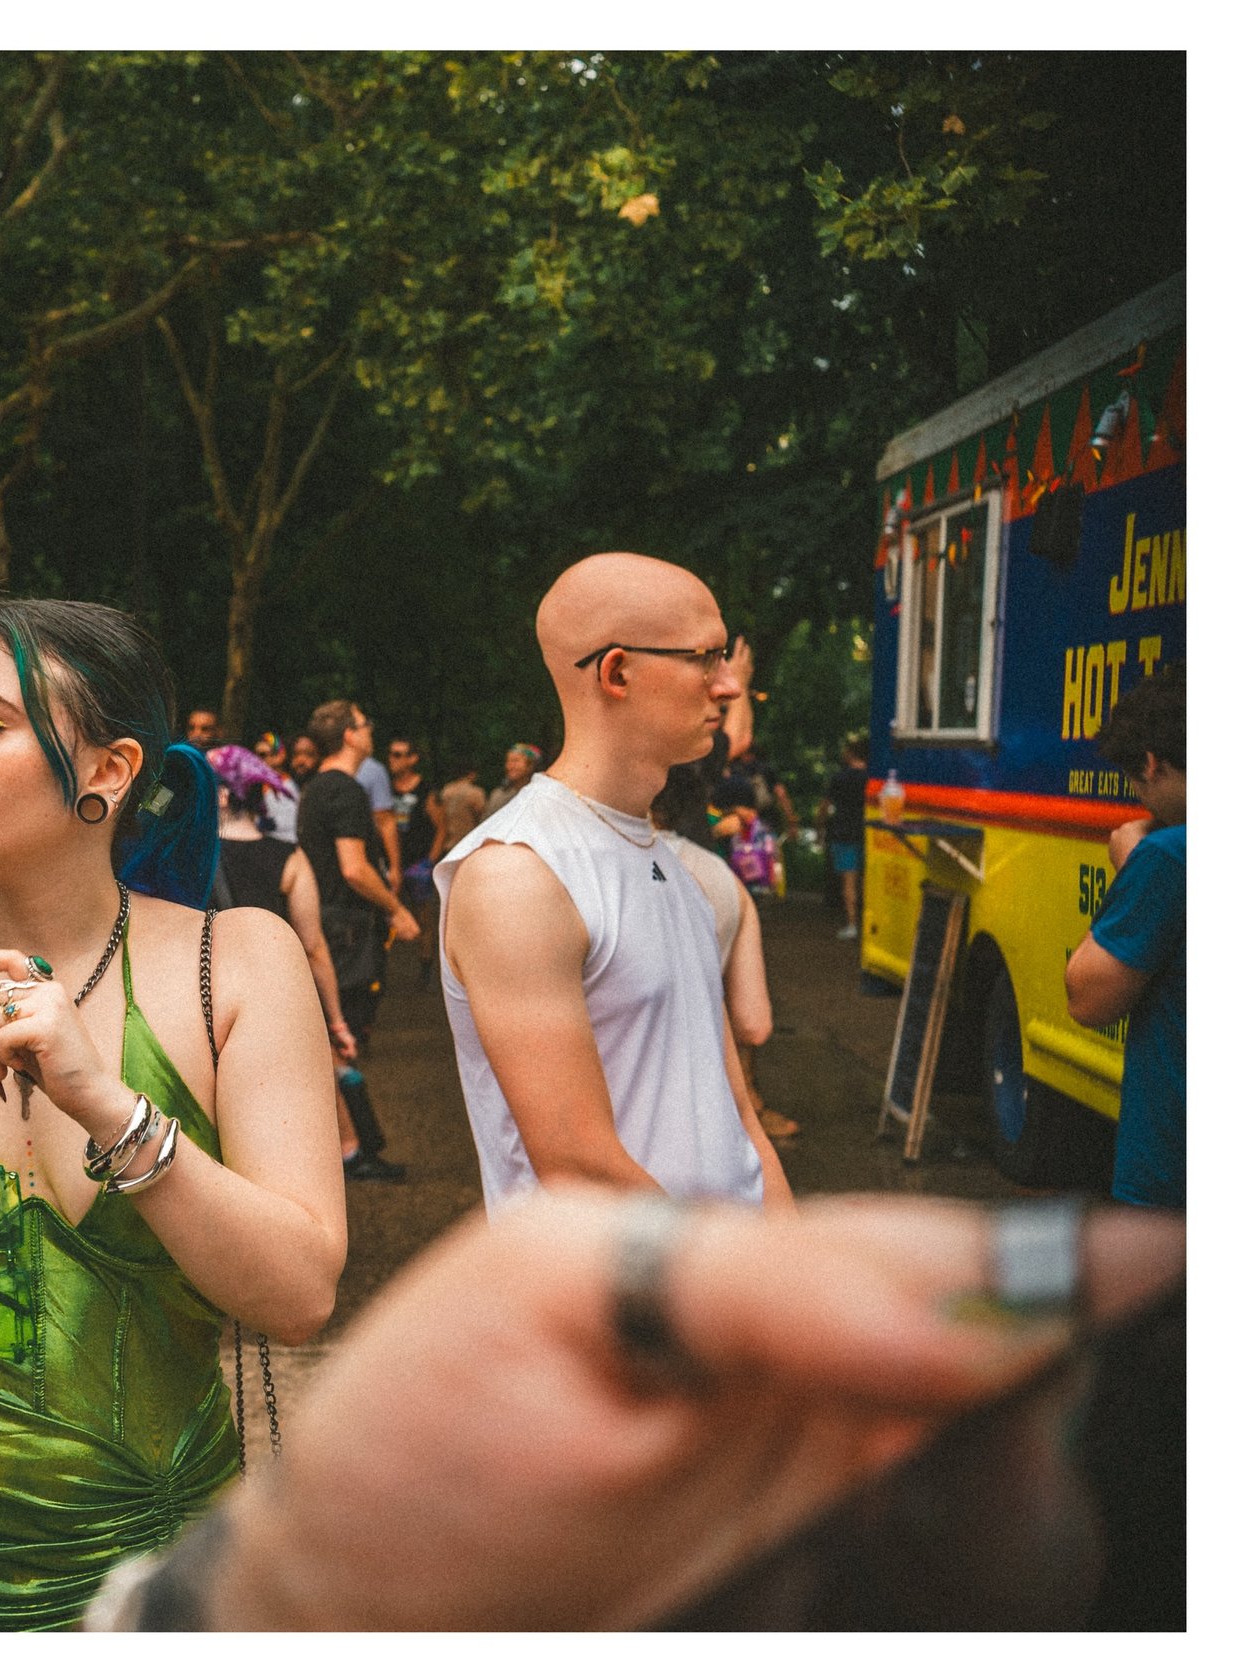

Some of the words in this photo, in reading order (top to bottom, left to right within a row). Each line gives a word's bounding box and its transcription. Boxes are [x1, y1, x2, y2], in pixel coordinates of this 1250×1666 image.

[1061, 640, 1127, 741] HOT
[1068, 770, 1095, 794] GREAT
[1098, 771, 1120, 796] EATS
[1078, 864, 1107, 917] 513
